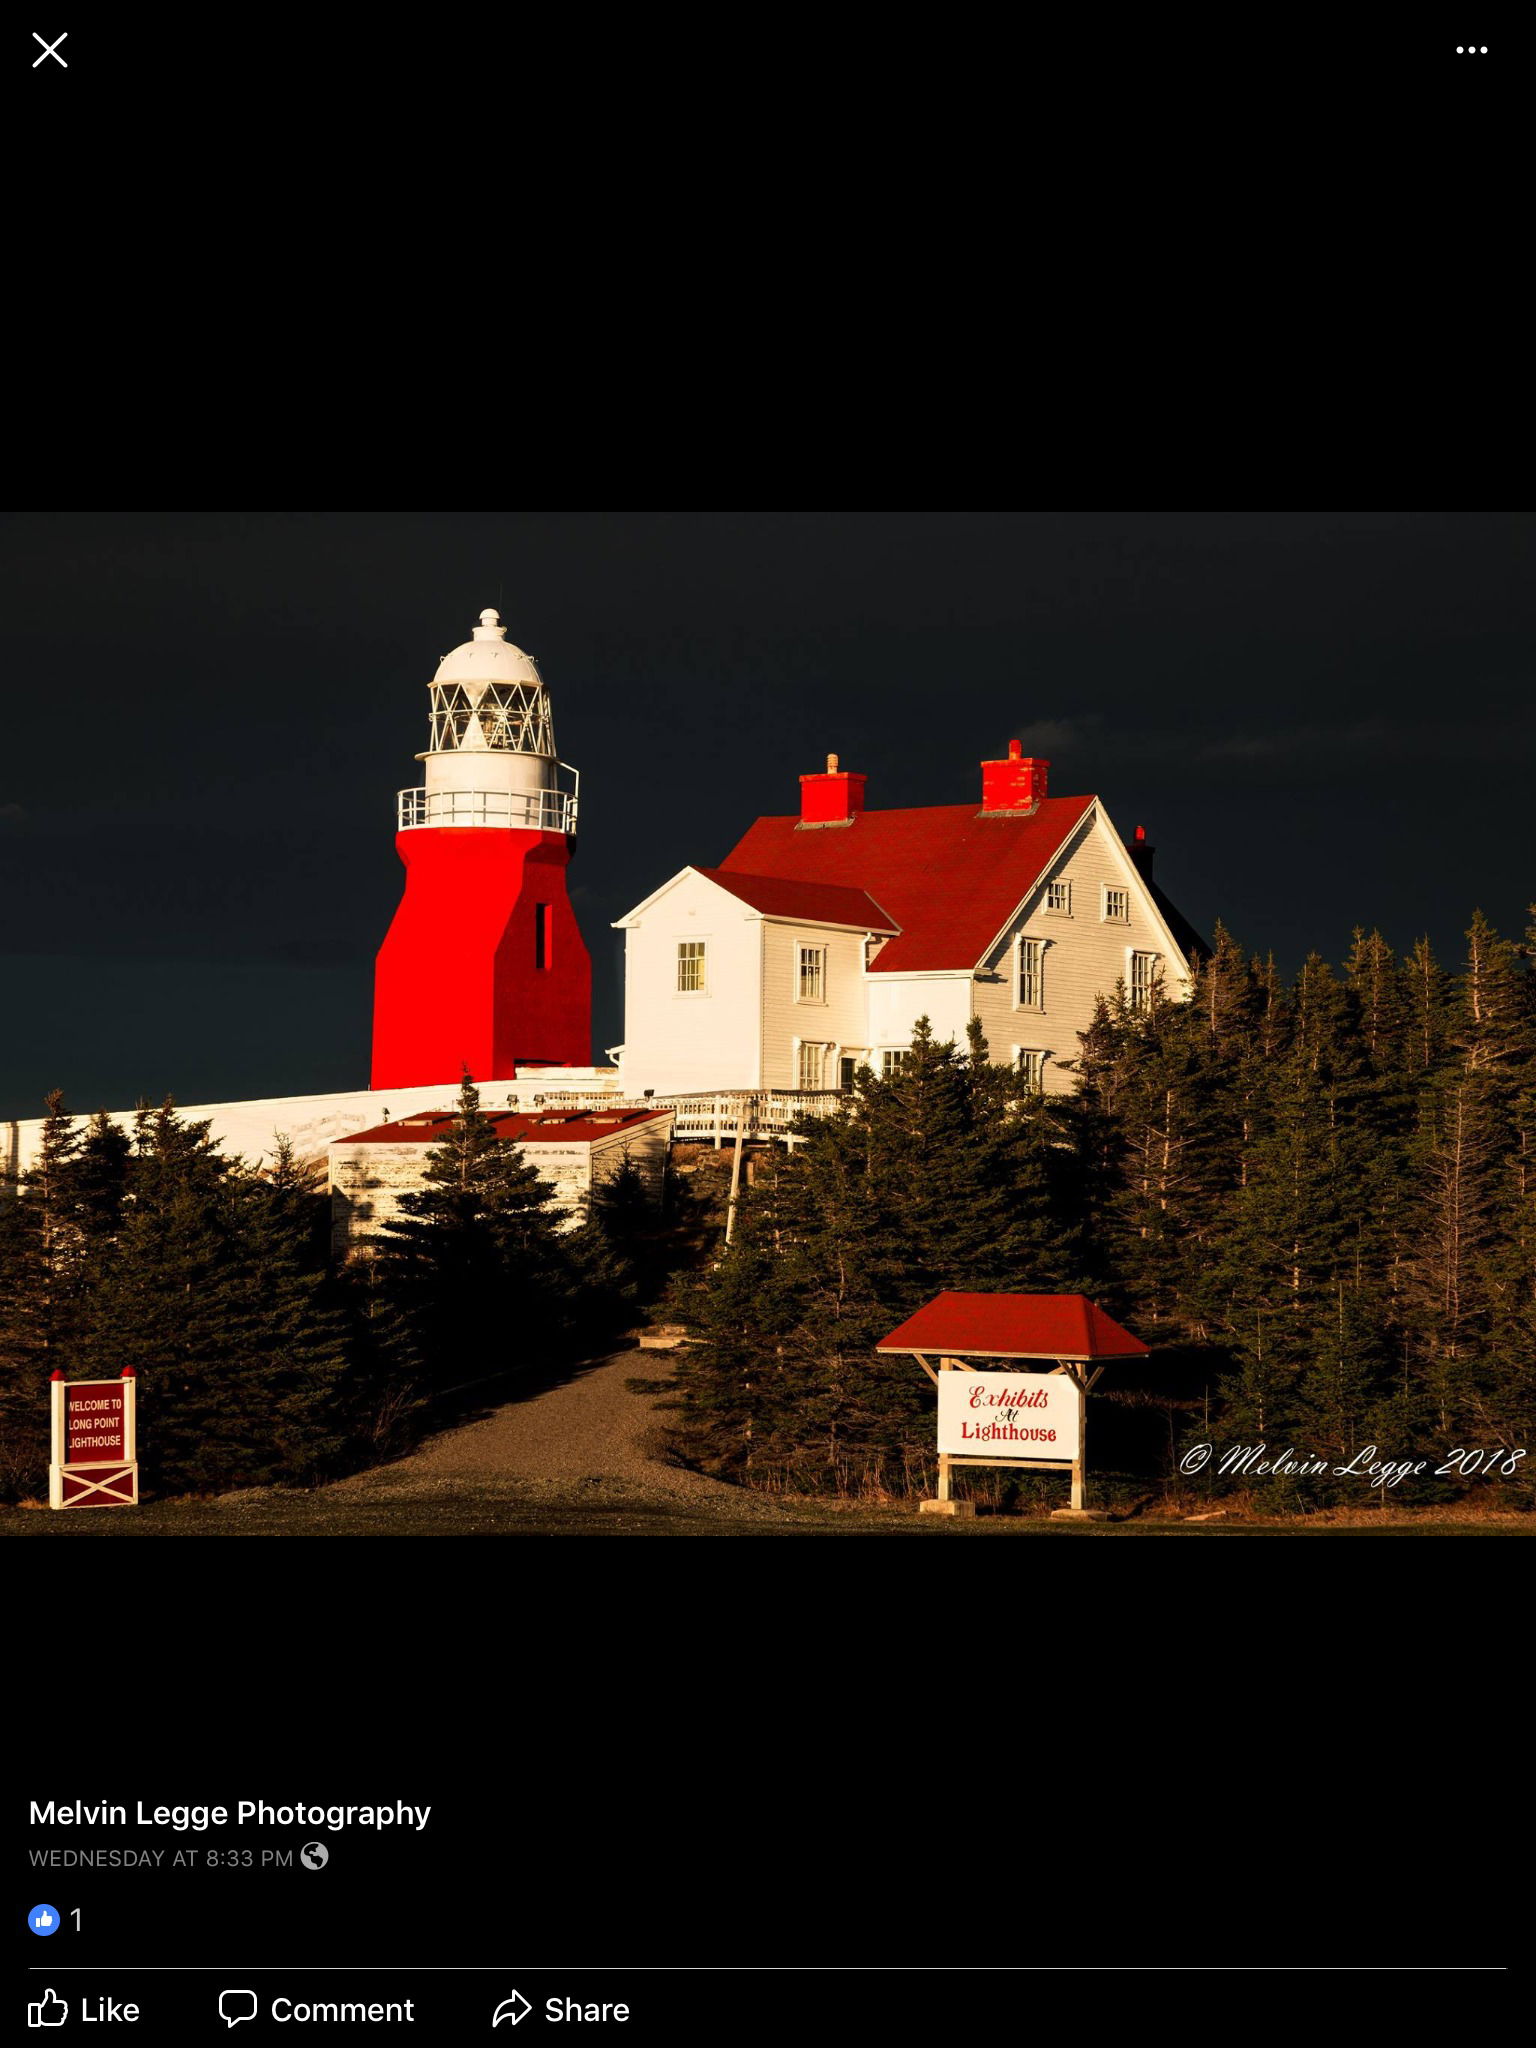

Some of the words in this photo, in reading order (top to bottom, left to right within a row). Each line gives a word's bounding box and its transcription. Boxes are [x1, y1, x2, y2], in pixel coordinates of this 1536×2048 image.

[111, 1398, 122, 1409] TO
[969, 1385, 1049, 1409] Exhibits
[994, 1408, 1020, 1422] At
[68, 1418, 92, 1430] LONG
[94, 1417, 119, 1428] POINT
[961, 1422, 1057, 1442] Lighthouse
